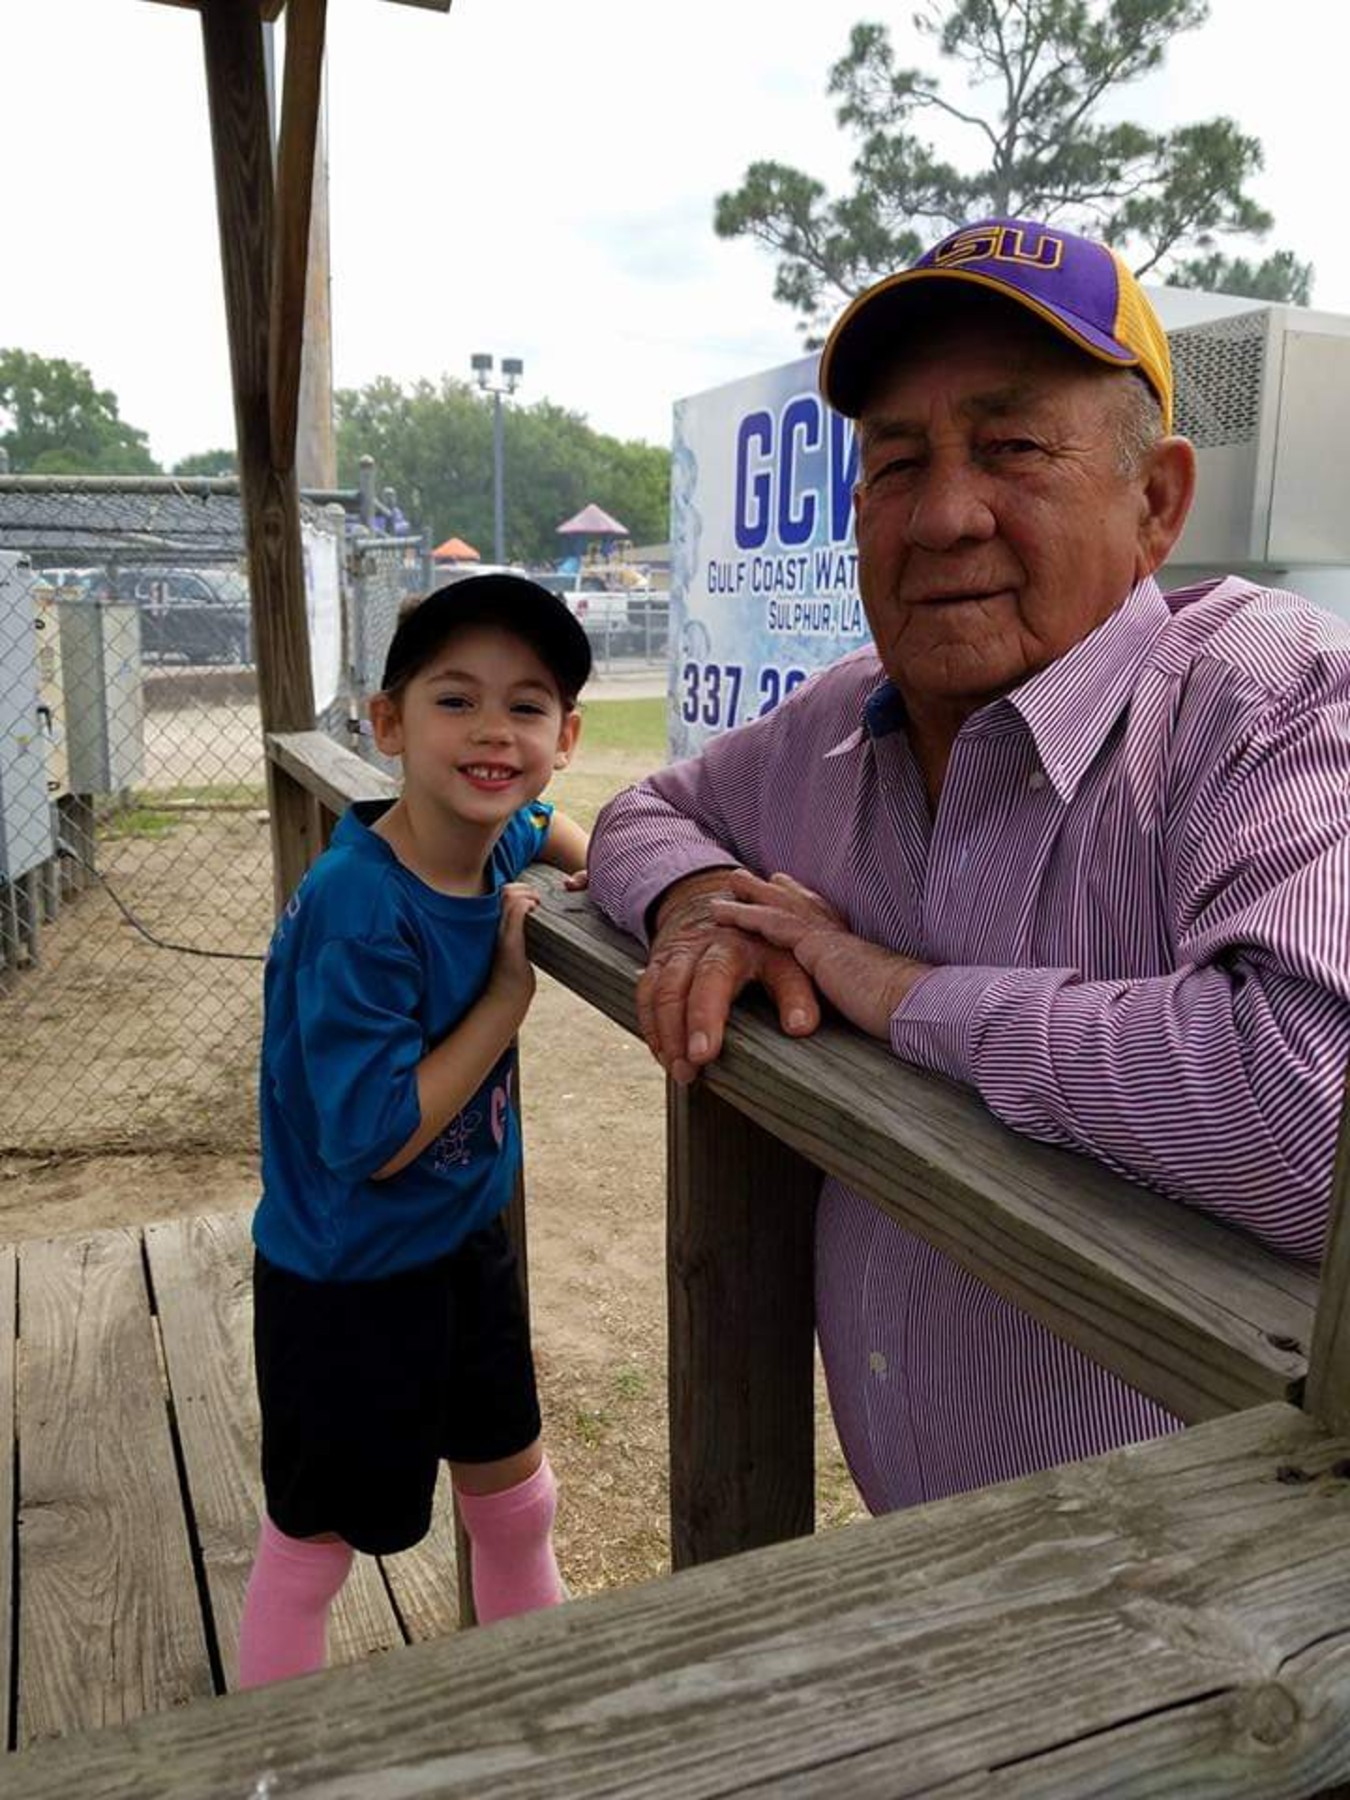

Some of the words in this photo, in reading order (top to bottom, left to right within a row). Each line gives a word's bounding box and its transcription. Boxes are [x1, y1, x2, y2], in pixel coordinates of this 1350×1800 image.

[708, 560, 746, 593] GULF
[752, 557, 808, 593] COAST
[768, 600, 836, 632] SULPHUR,
[841, 600, 862, 632] LA
